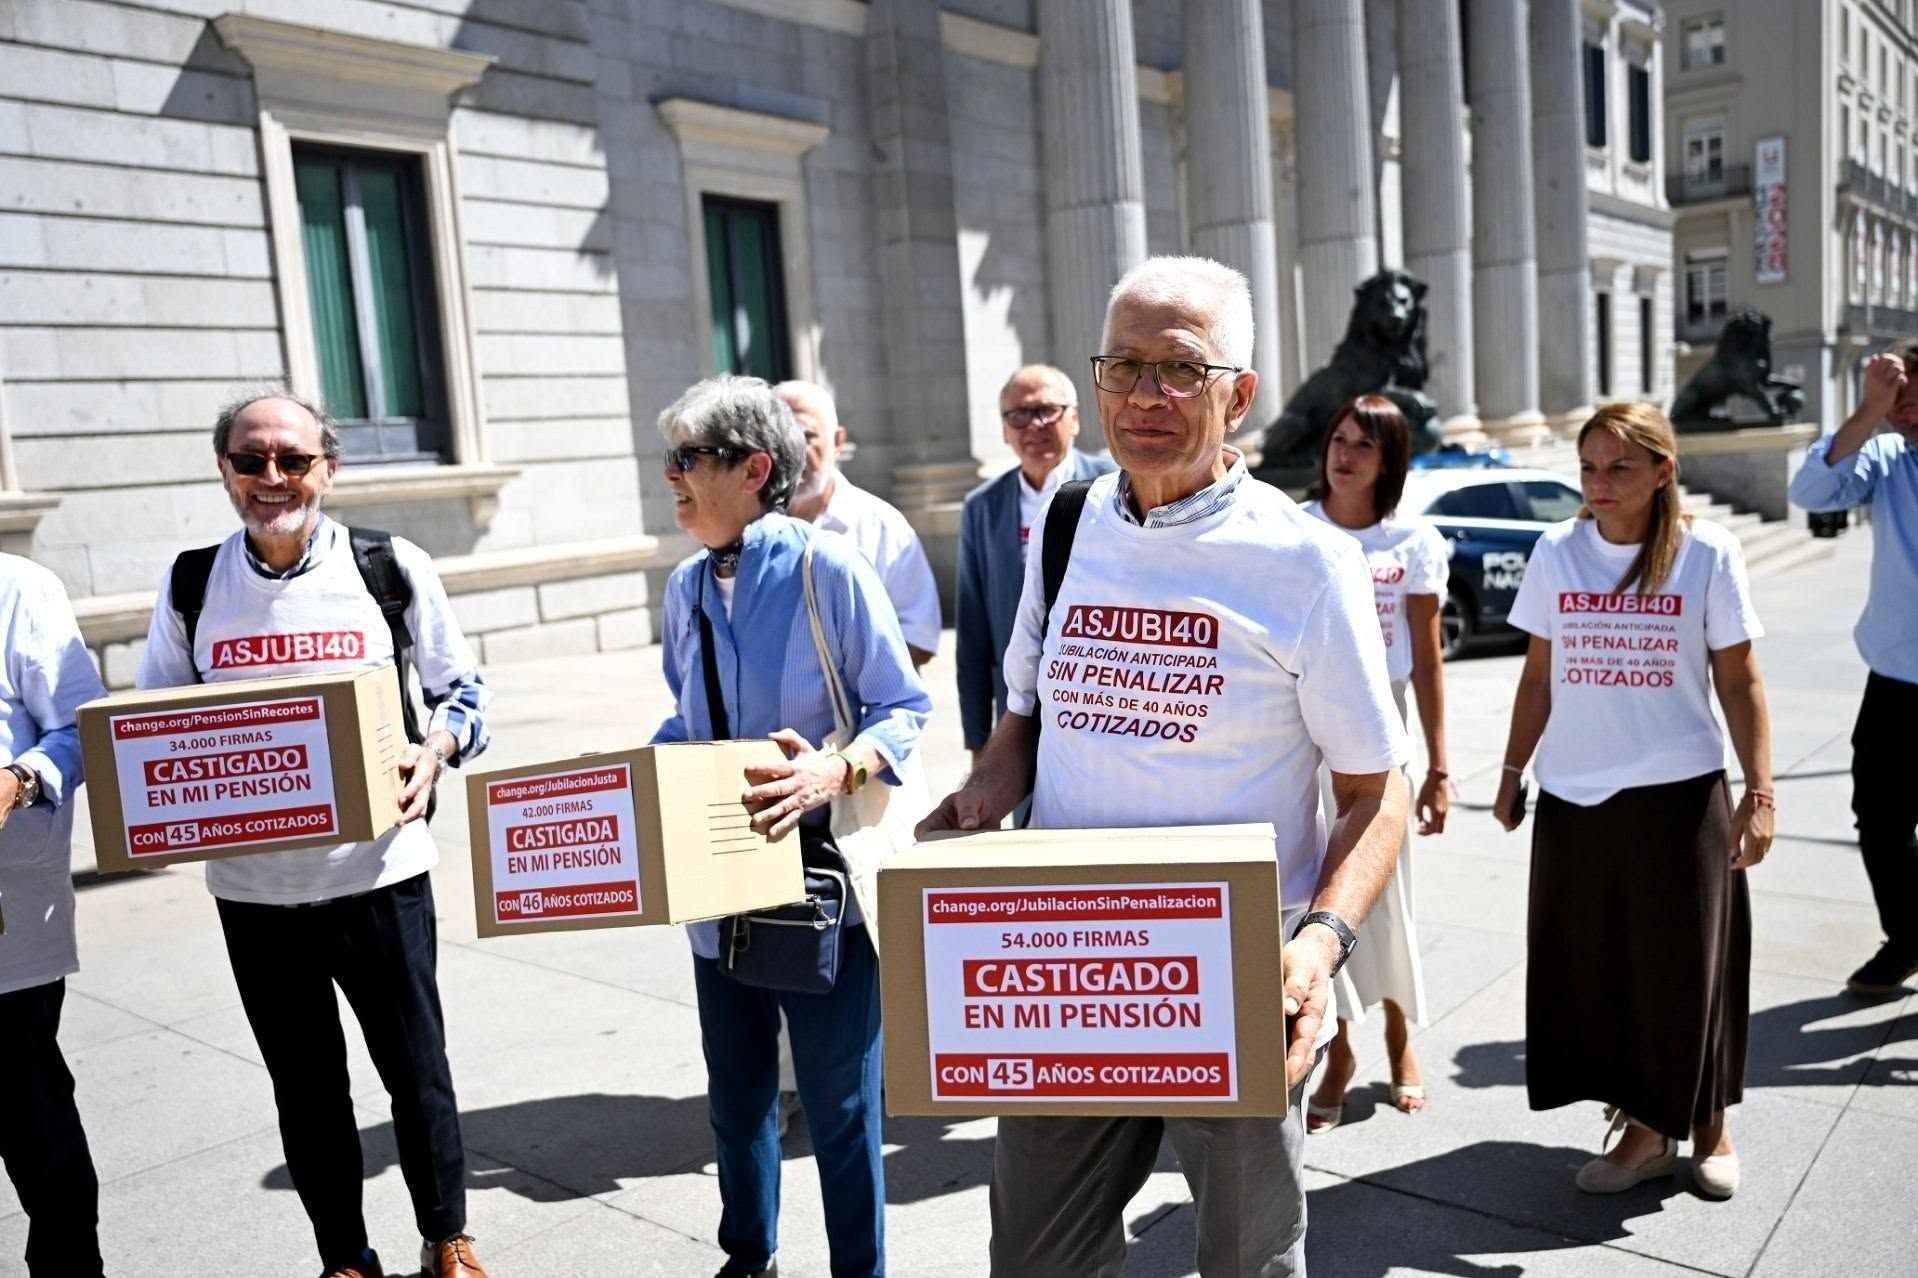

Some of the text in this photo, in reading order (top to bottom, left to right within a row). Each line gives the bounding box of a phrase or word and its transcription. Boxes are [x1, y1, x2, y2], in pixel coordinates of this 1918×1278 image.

[1563, 594, 1675, 614] ASJUBI40
[1065, 608, 1212, 645] ASJUBI40
[1614, 622, 1676, 632] ANTICIPADA
[216, 634, 360, 667] ASJUBI40
[1582, 635, 1679, 653] PENALIZAR
[1130, 654, 1217, 669] ANTICIPADA
[1607, 658, 1623, 666] DE
[1643, 657, 1676, 667] AÑOS
[1047, 660, 1225, 696] SIN PENALIZAR
[1052, 688, 1208, 718] CON MÁS DE 40 AÑOS
[120, 705, 313, 733] change.org/PensionSinRecortes
[1057, 711, 1199, 743] COTIZADOS
[169, 730, 273, 752] 34.000 FIRMAS
[153, 748, 301, 783] CASTIGADO
[147, 773, 312, 807] EN MI PENSIÓN
[497, 773, 617, 798] change.org/JubilacionJusta
[522, 799, 593, 819] 42.000 FIRMAS
[133, 813, 328, 846] CON 45 AÑOS COTIZADOS
[512, 820, 614, 849] CASTIGADA
[508, 844, 622, 874] EN MI PENSIÓN
[499, 889, 633, 912] CON 46 AÑOS COTIZADOS
[932, 894, 1217, 916] change.org/JubilacionSinPenalizacion
[1001, 930, 1150, 949] 54.000 FIRMAS
[975, 961, 1189, 993] CASTIGADO
[964, 997, 1201, 1029] EN MI PENSIÓN
[941, 1062, 1221, 1086] CON 45 AÑOS COTIZADOS
